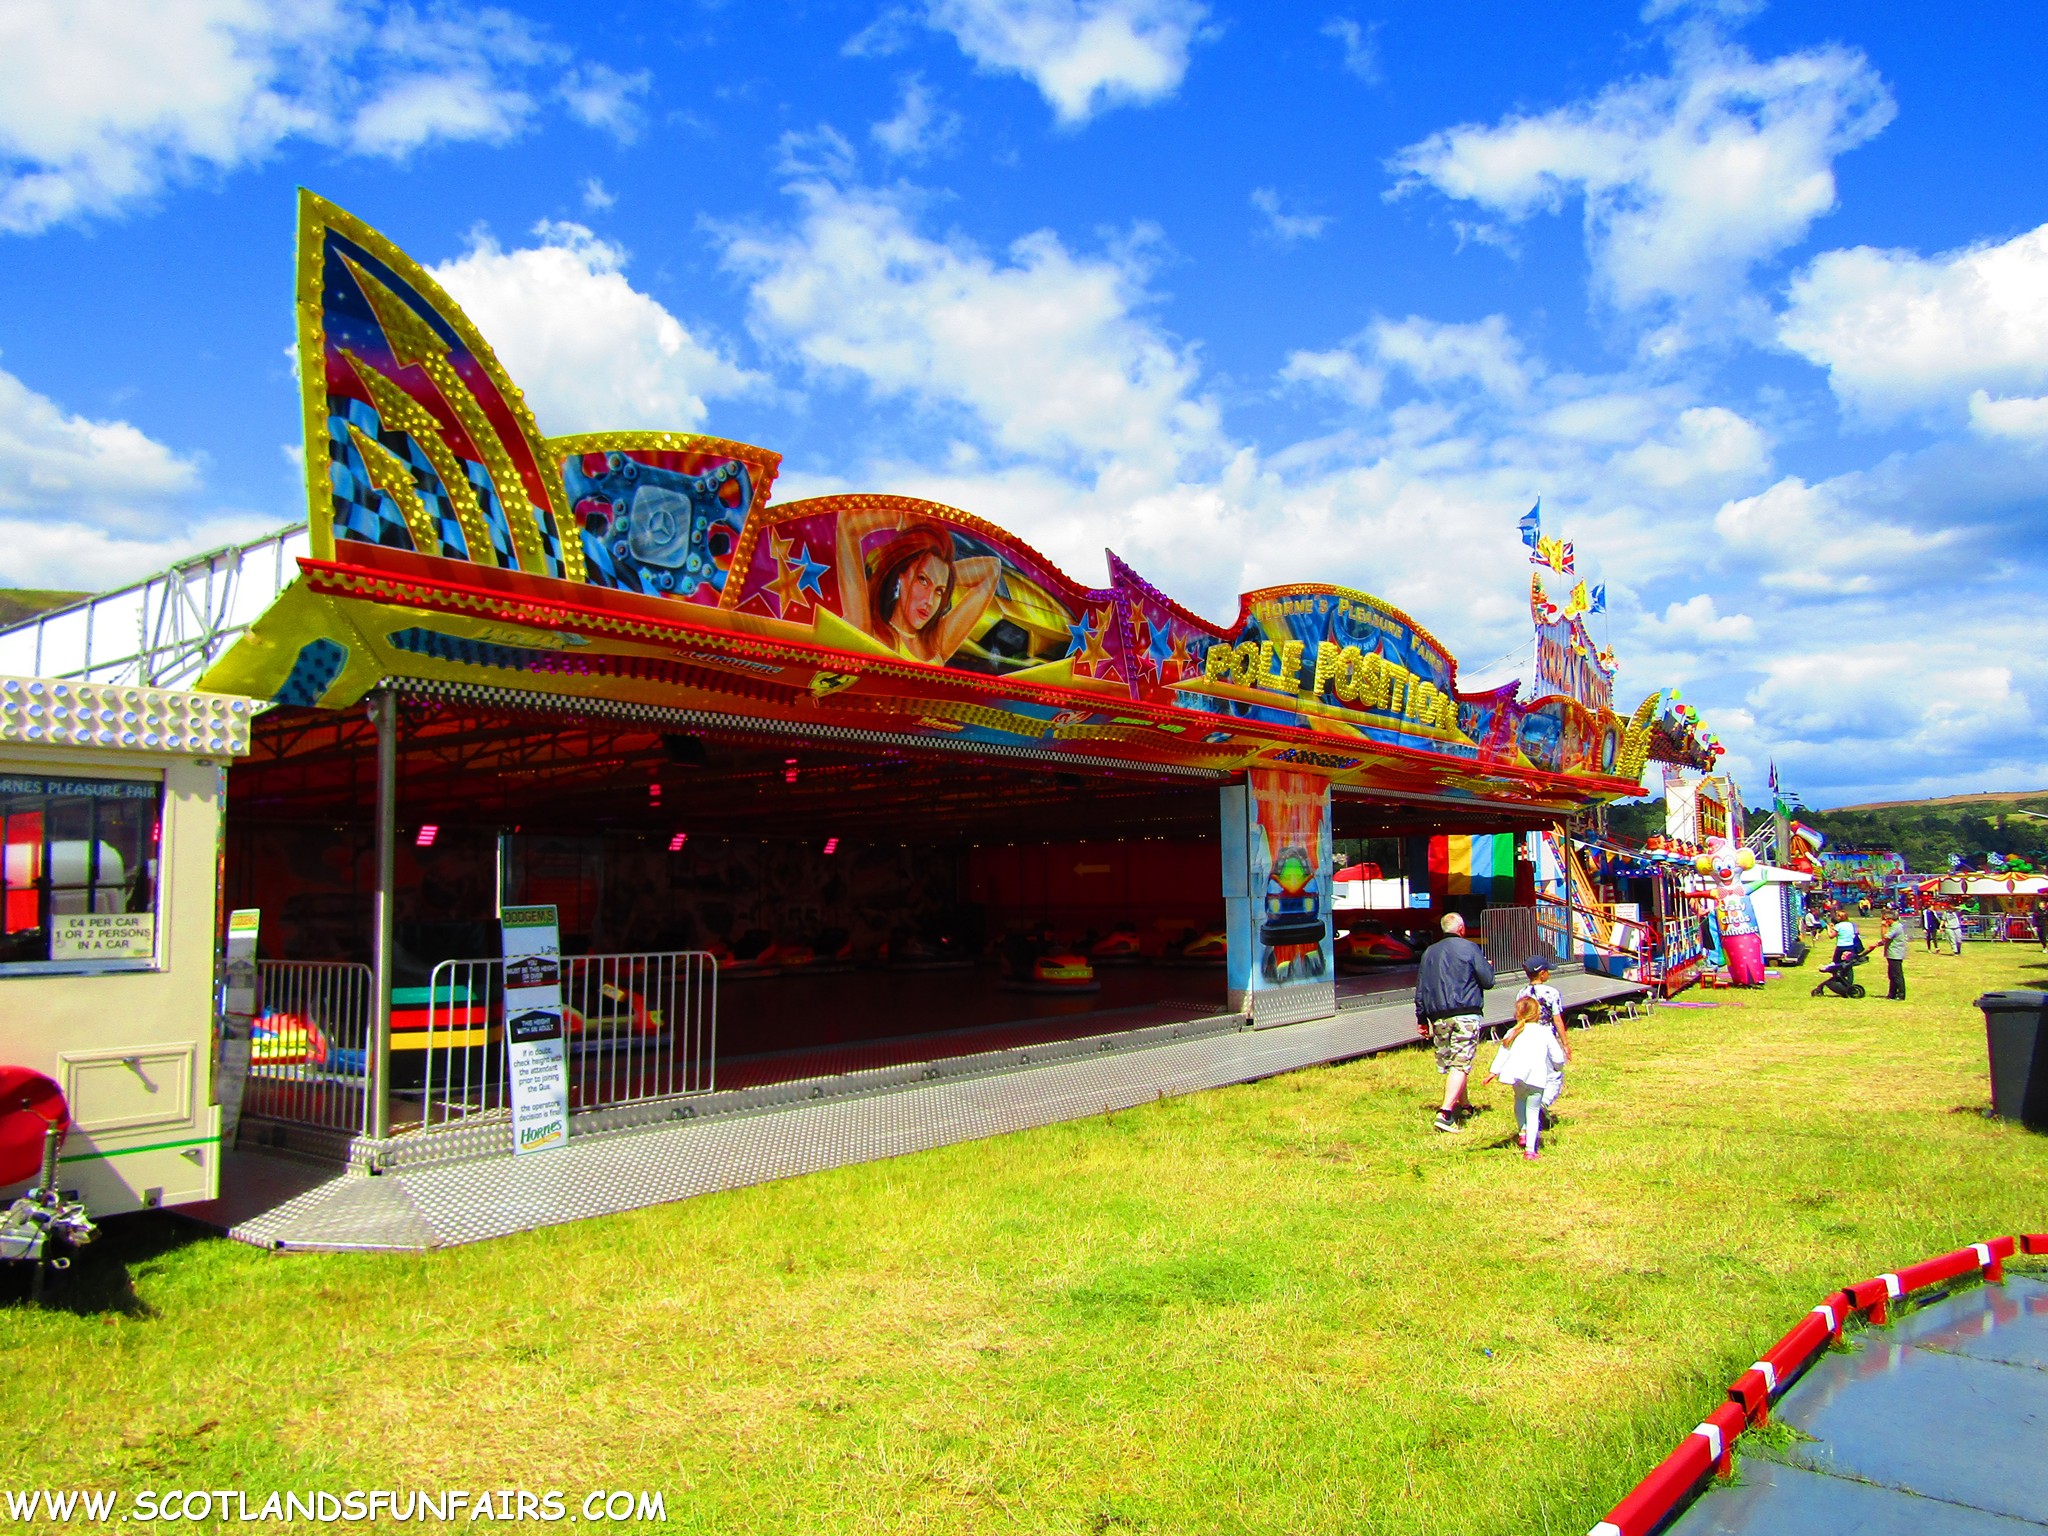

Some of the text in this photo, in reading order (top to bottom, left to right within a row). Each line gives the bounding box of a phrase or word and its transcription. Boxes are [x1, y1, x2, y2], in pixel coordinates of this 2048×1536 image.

[1256, 594, 1443, 673] HORNE'S PLEASURE FAIRS
[1203, 640, 1458, 733] POLE POSITION
[0, 779, 156, 798] RNES PLEASURE FAIR
[89, 919, 112, 927] PER
[115, 918, 139, 927] CAR
[65, 930, 82, 939] OR
[87, 930, 95, 939] 2
[98, 928, 151, 938] PERSONS
[1719, 925, 1759, 936] unhouse
[78, 940, 130, 950] IN A CAR
